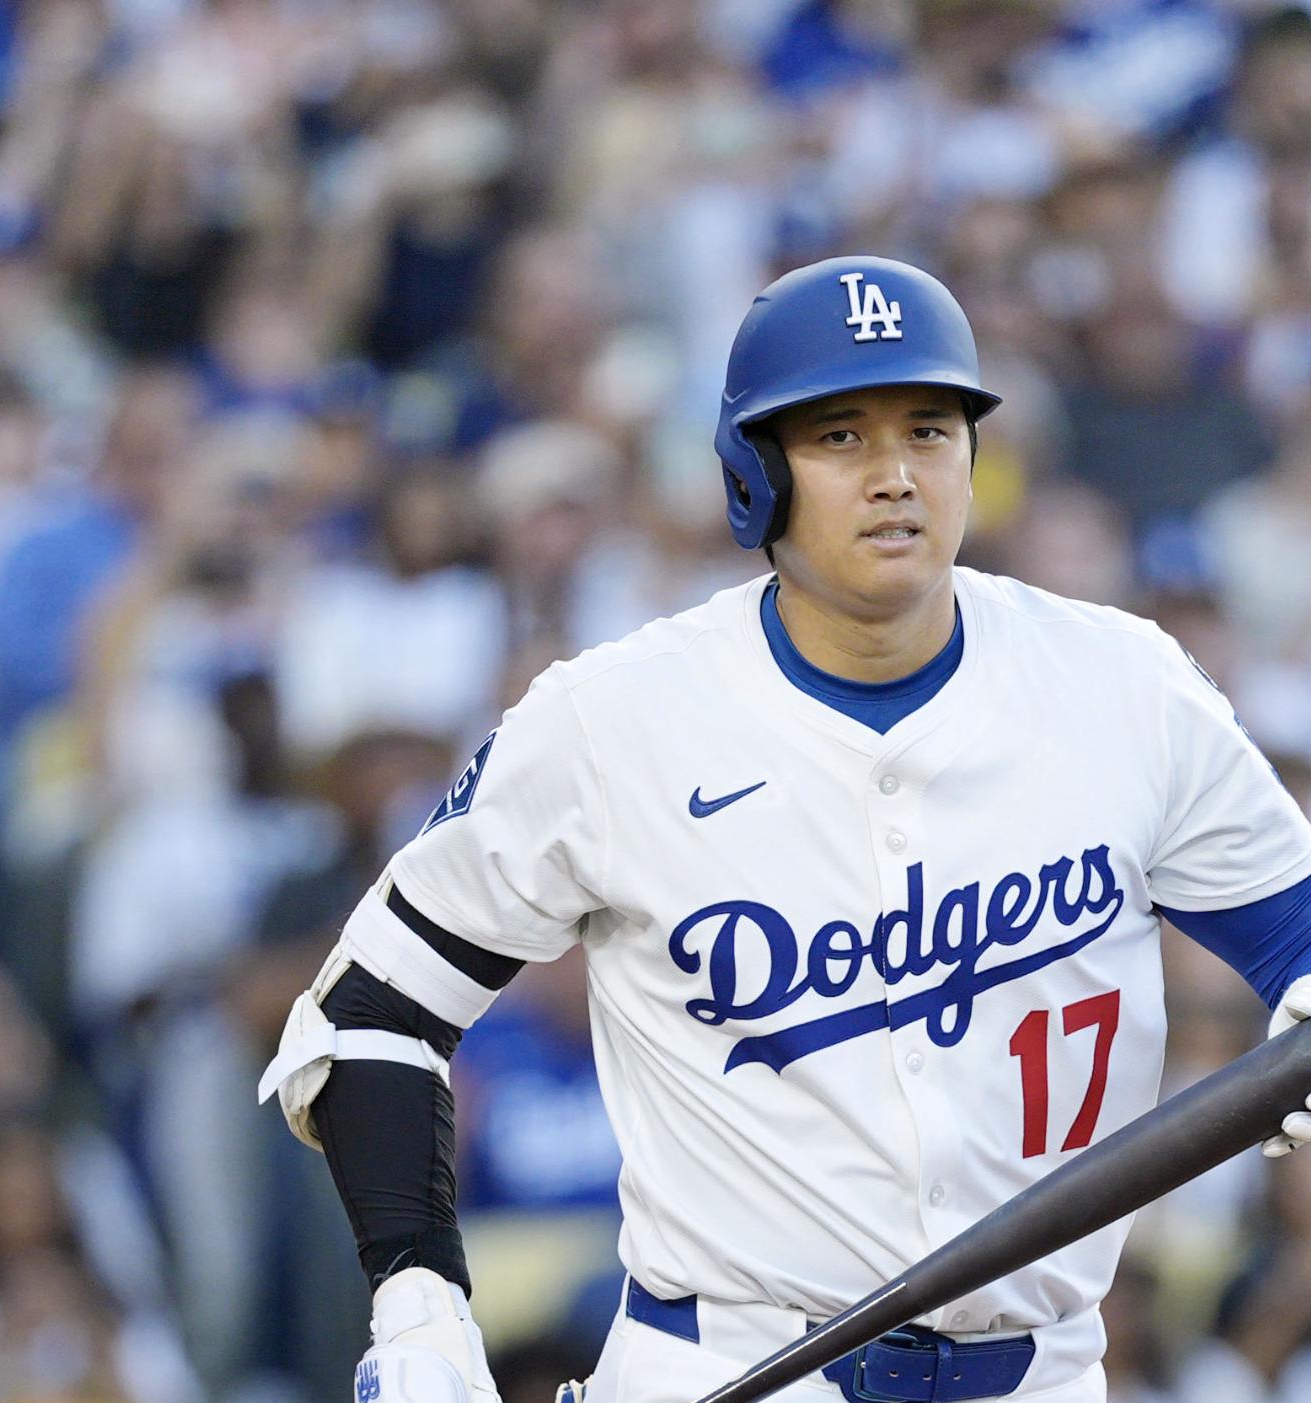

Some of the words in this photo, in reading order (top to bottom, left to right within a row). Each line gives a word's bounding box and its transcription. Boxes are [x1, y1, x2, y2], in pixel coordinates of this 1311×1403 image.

[839, 272, 903, 342] LA
[668, 843, 1125, 1050] Dodgers
[1008, 988, 1121, 1159] 17
